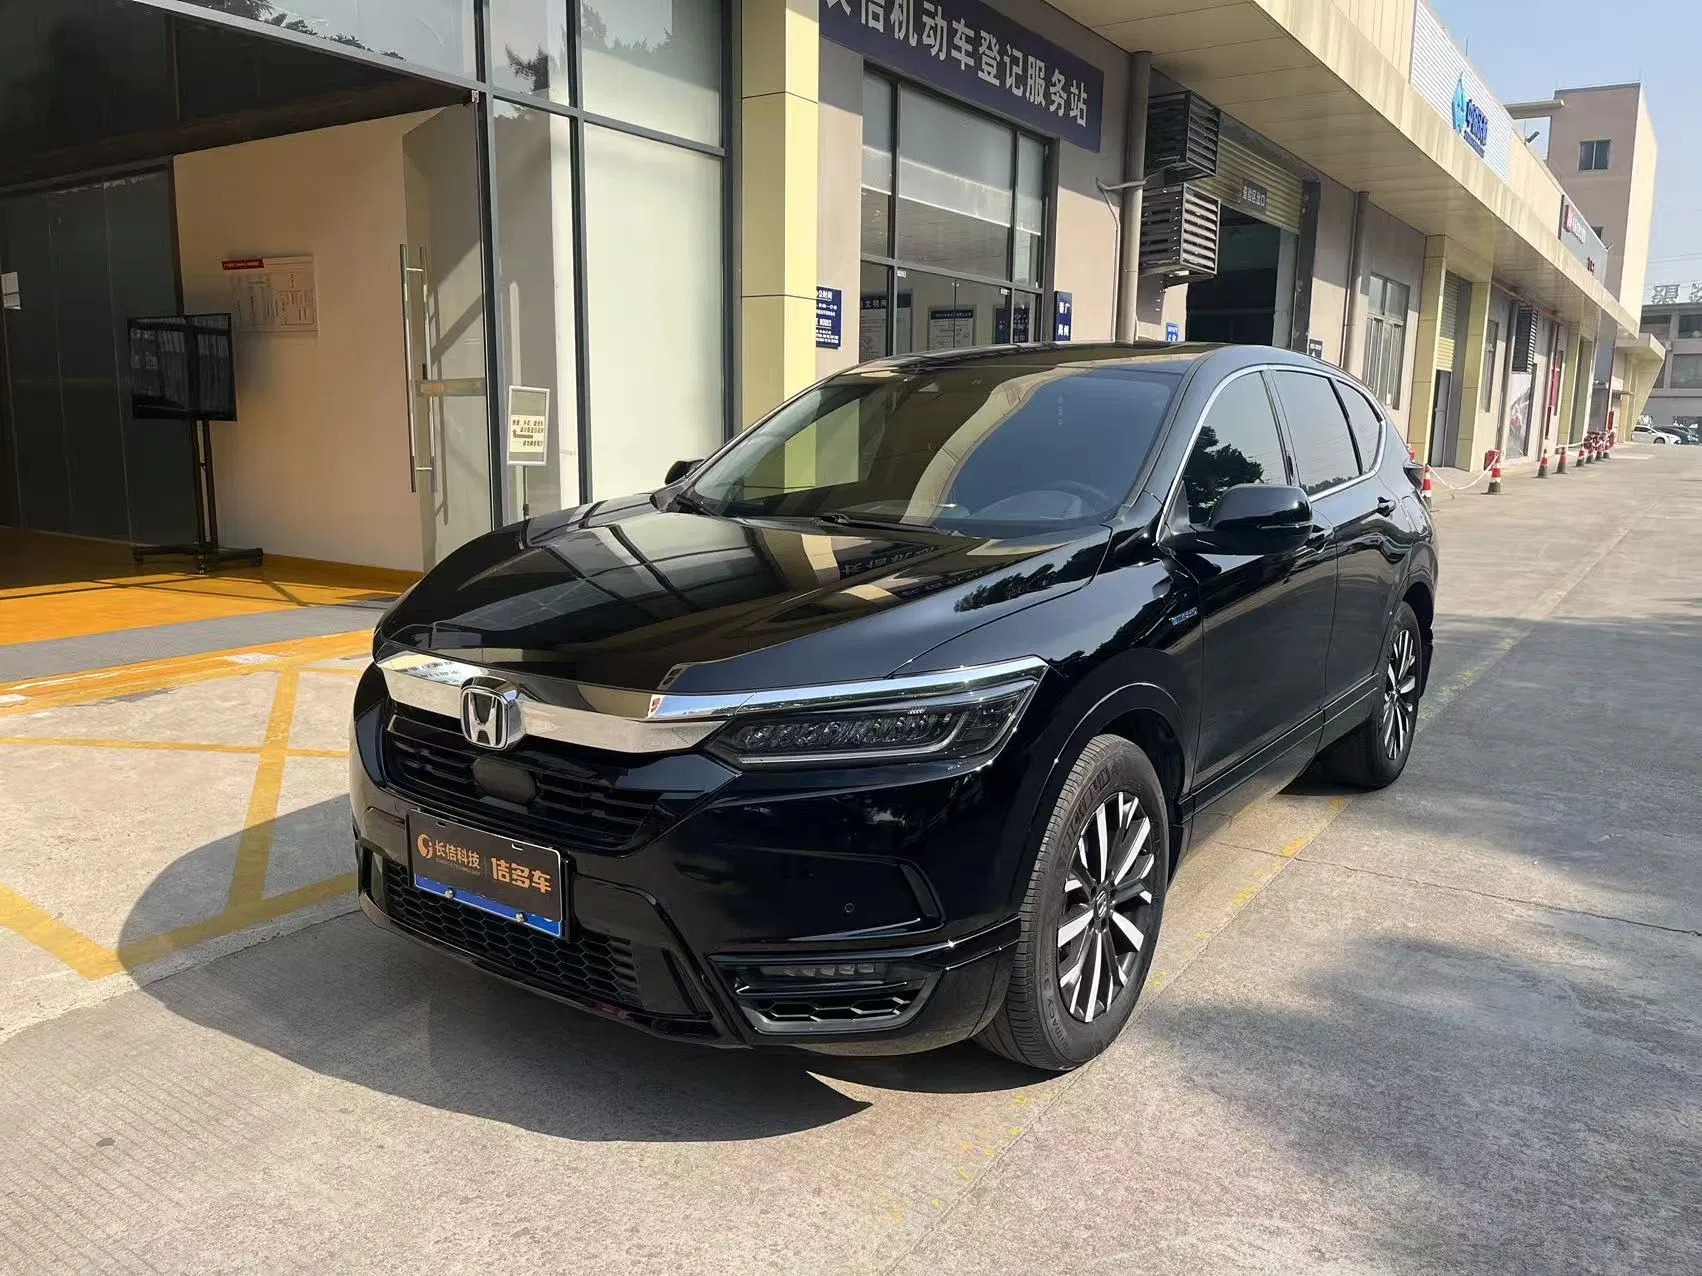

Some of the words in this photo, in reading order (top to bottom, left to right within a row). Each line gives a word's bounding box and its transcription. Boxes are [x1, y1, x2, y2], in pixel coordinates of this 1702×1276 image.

[826, 0, 1088, 128] 信机动车登记服务站
[435, 839, 481, 869] 长信科技
[490, 857, 552, 894] 信多车
